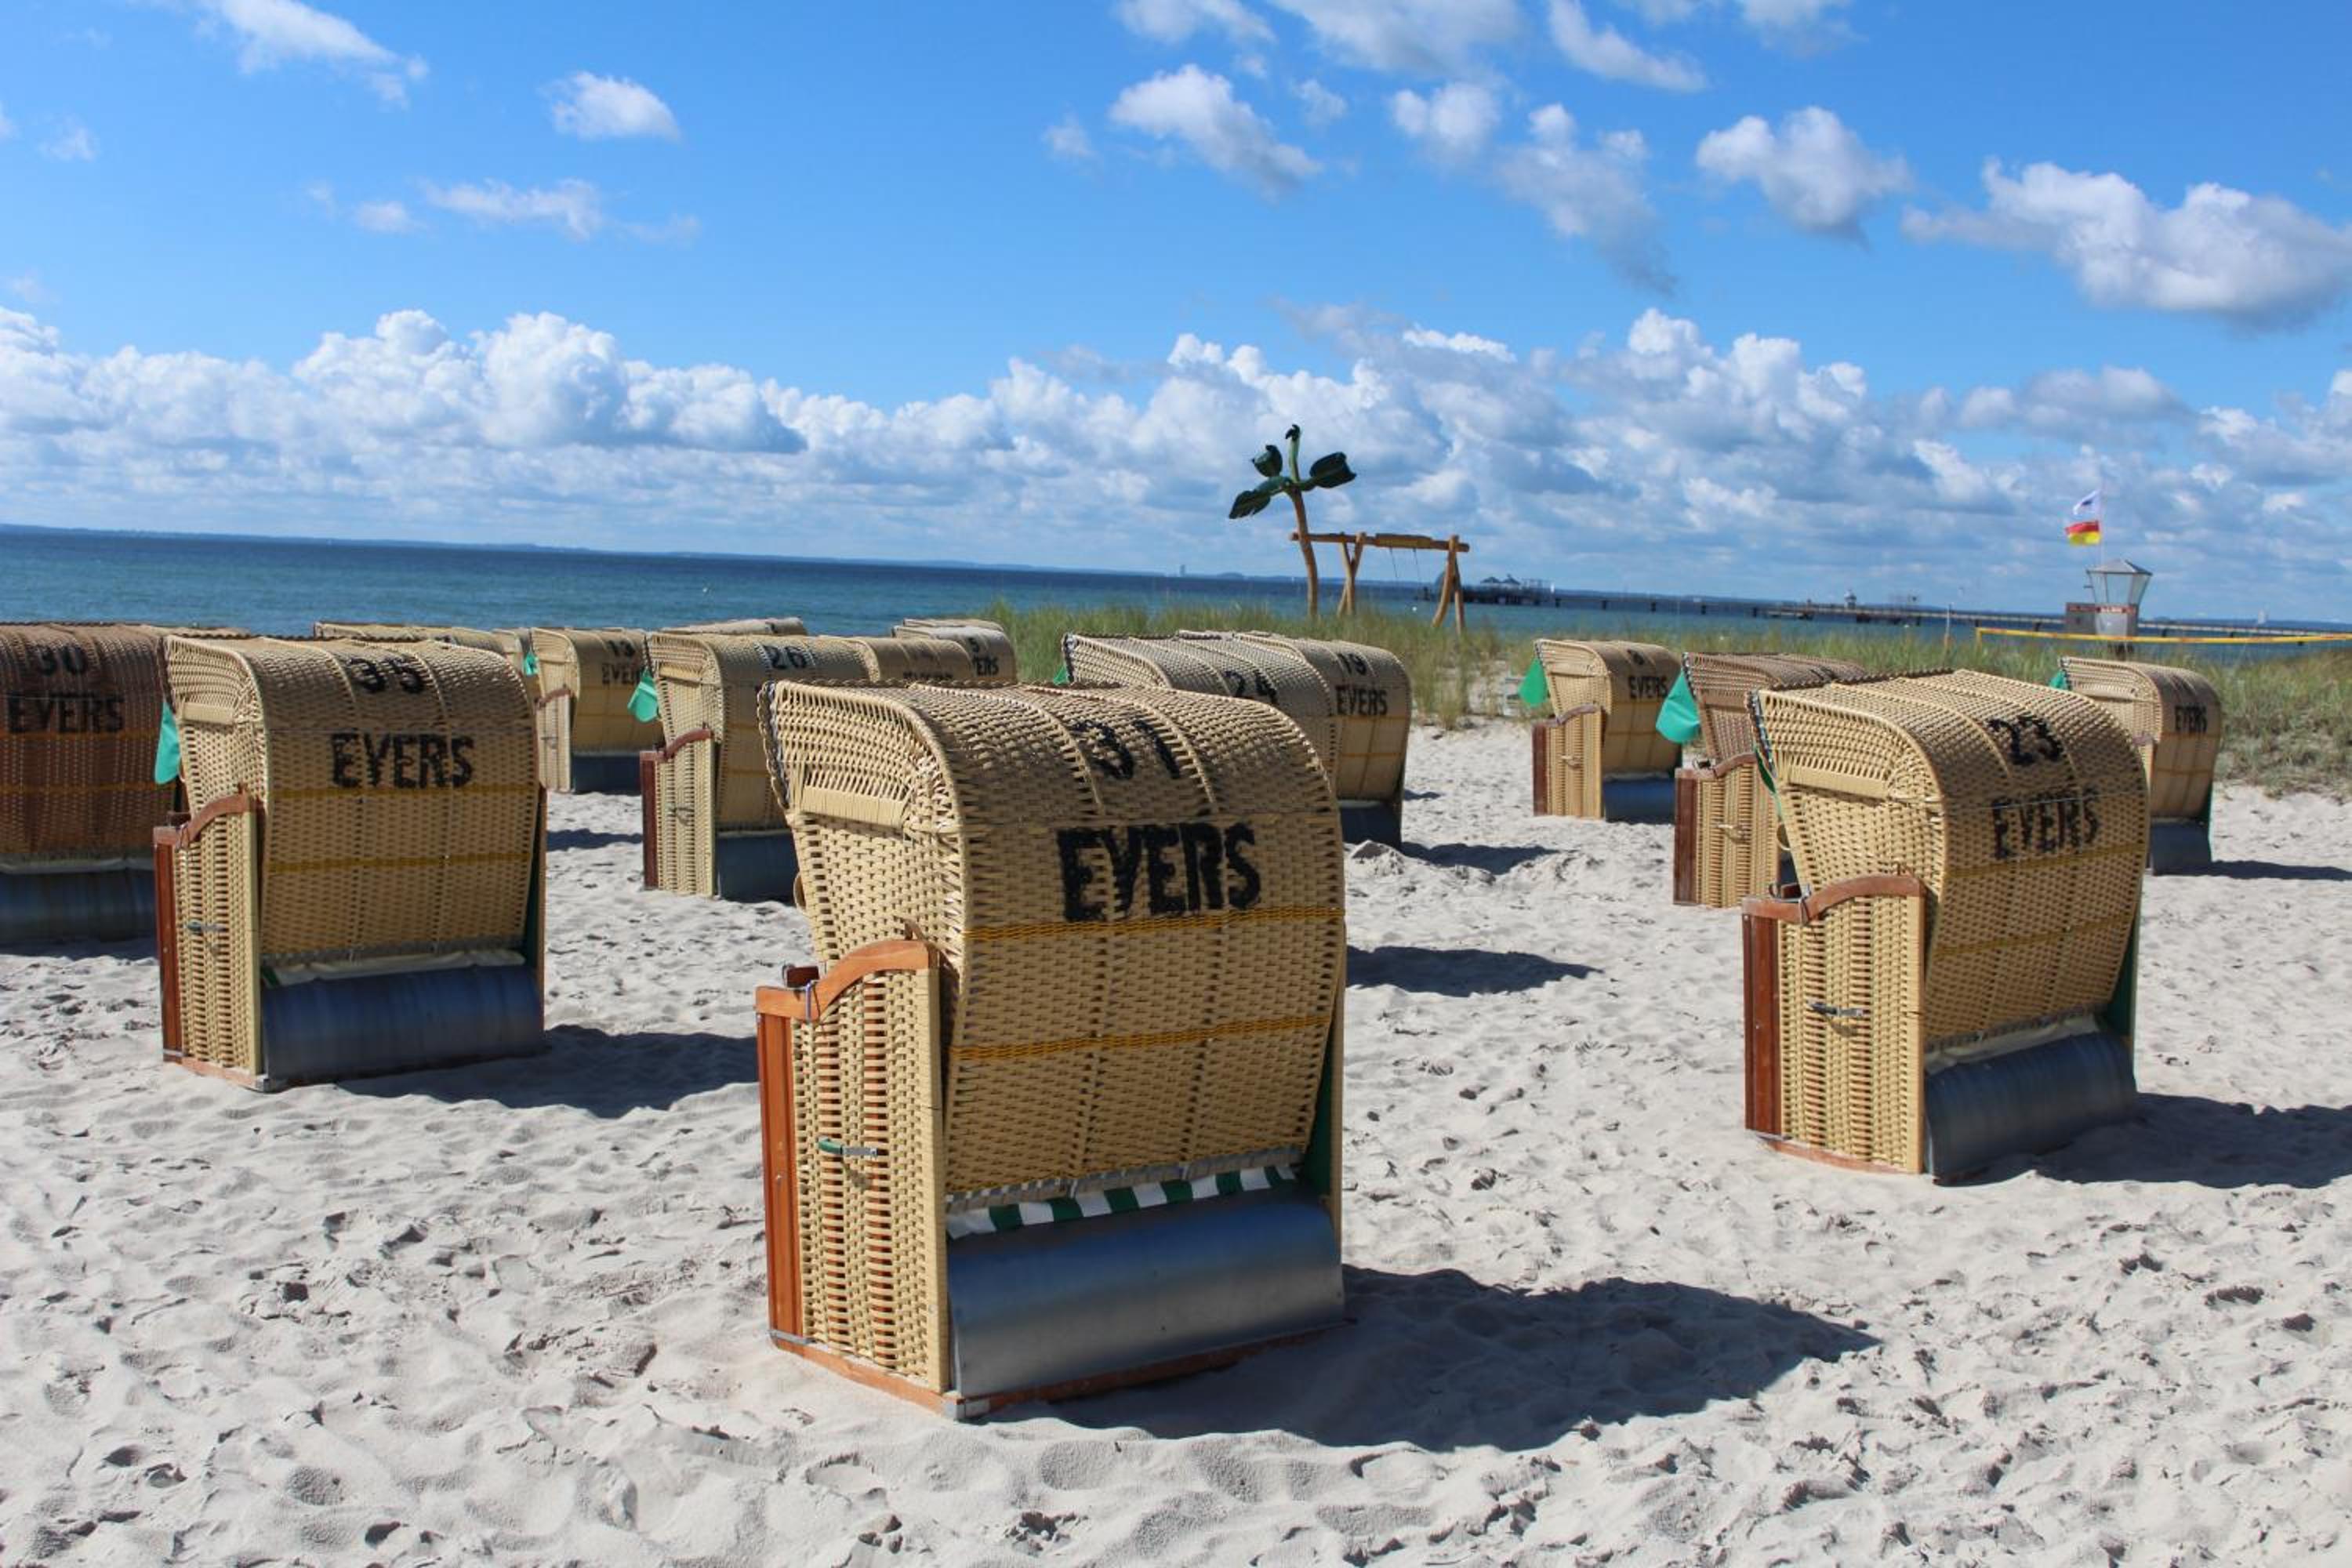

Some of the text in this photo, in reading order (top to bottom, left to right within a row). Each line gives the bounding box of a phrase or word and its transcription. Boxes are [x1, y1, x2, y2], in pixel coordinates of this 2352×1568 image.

[1338, 652, 1368, 676] 19
[1628, 675, 1671, 699] EVERS
[7, 690, 125, 733] EVERS
[1335, 684, 1388, 716] EVERS
[2174, 704, 2208, 733] EVERS
[331, 729, 474, 789] EVERS
[1068, 718, 1181, 779] 31
[1987, 714, 2065, 766] 23
[1991, 786, 2099, 859] EVERS
[1055, 822, 1261, 921] EVERS
